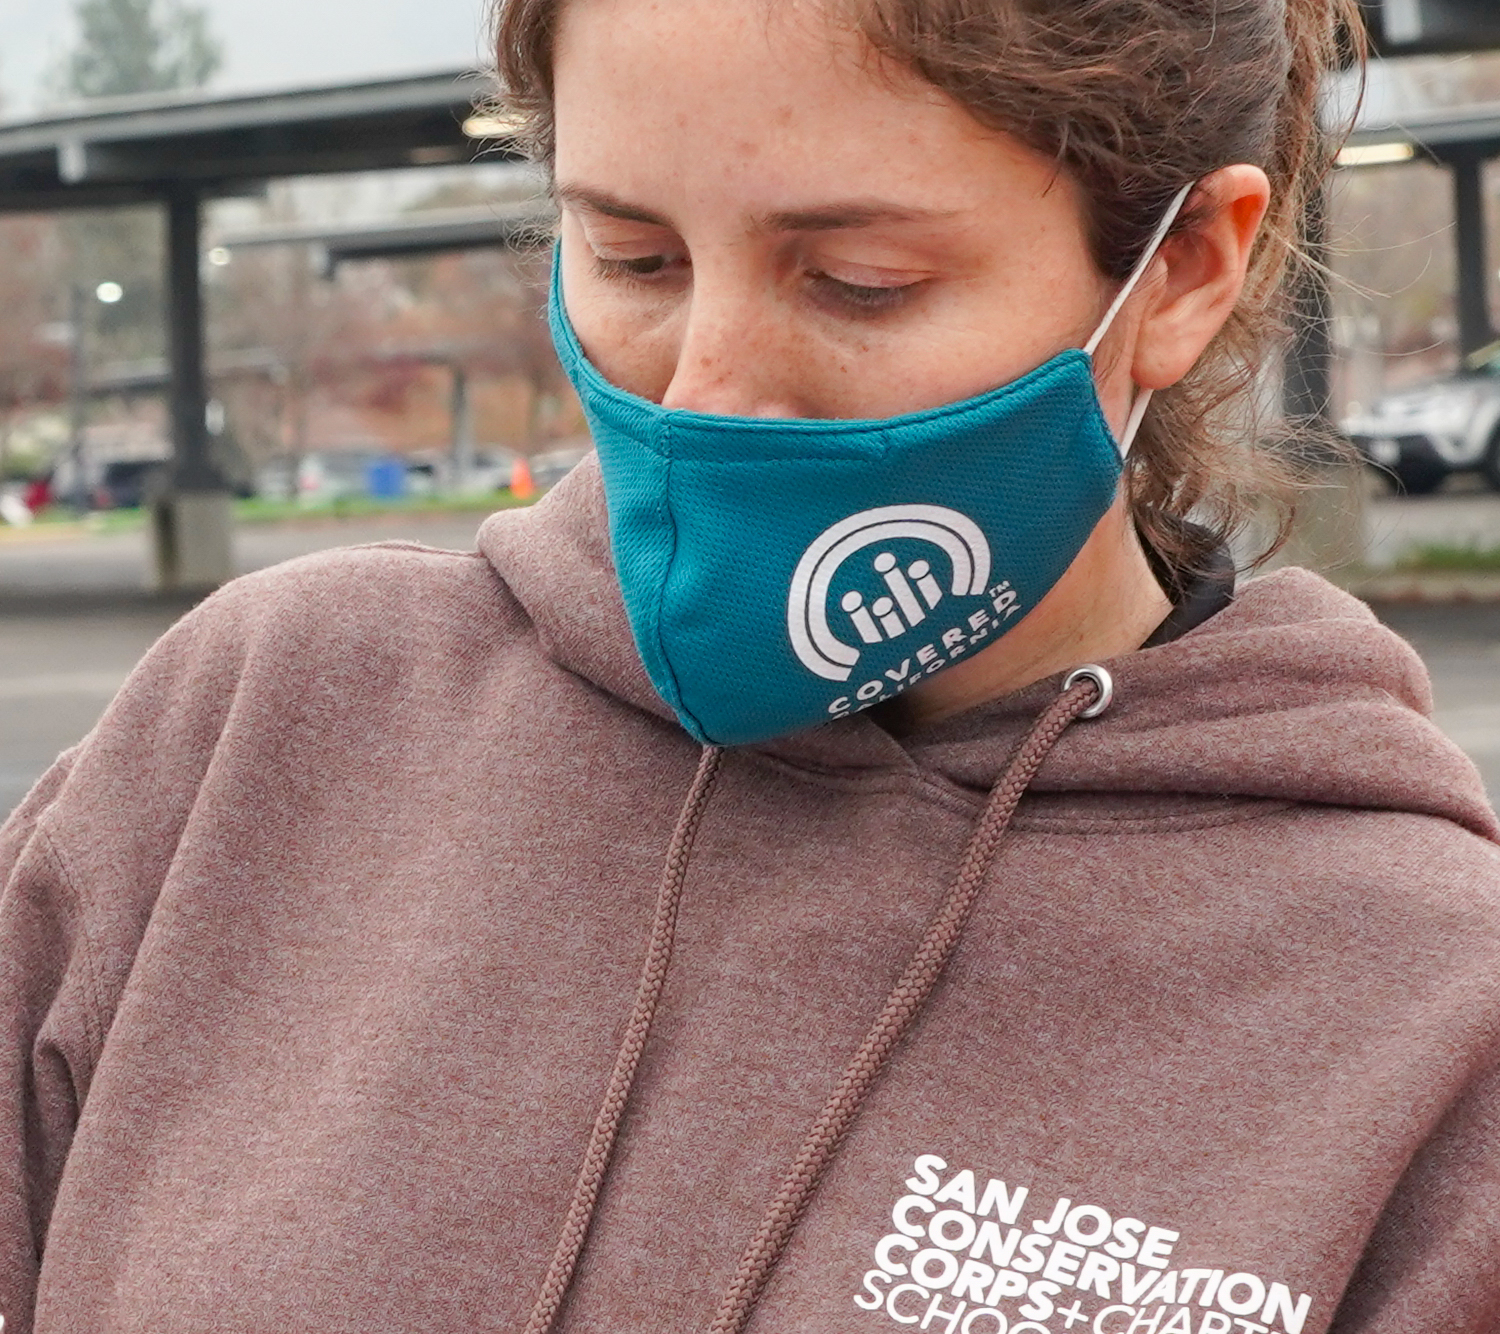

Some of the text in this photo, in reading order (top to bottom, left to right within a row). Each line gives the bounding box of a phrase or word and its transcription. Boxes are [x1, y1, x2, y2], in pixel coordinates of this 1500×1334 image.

[828, 589, 1018, 714] COVERED
[905, 1154, 1180, 1270] SAN JOSE
